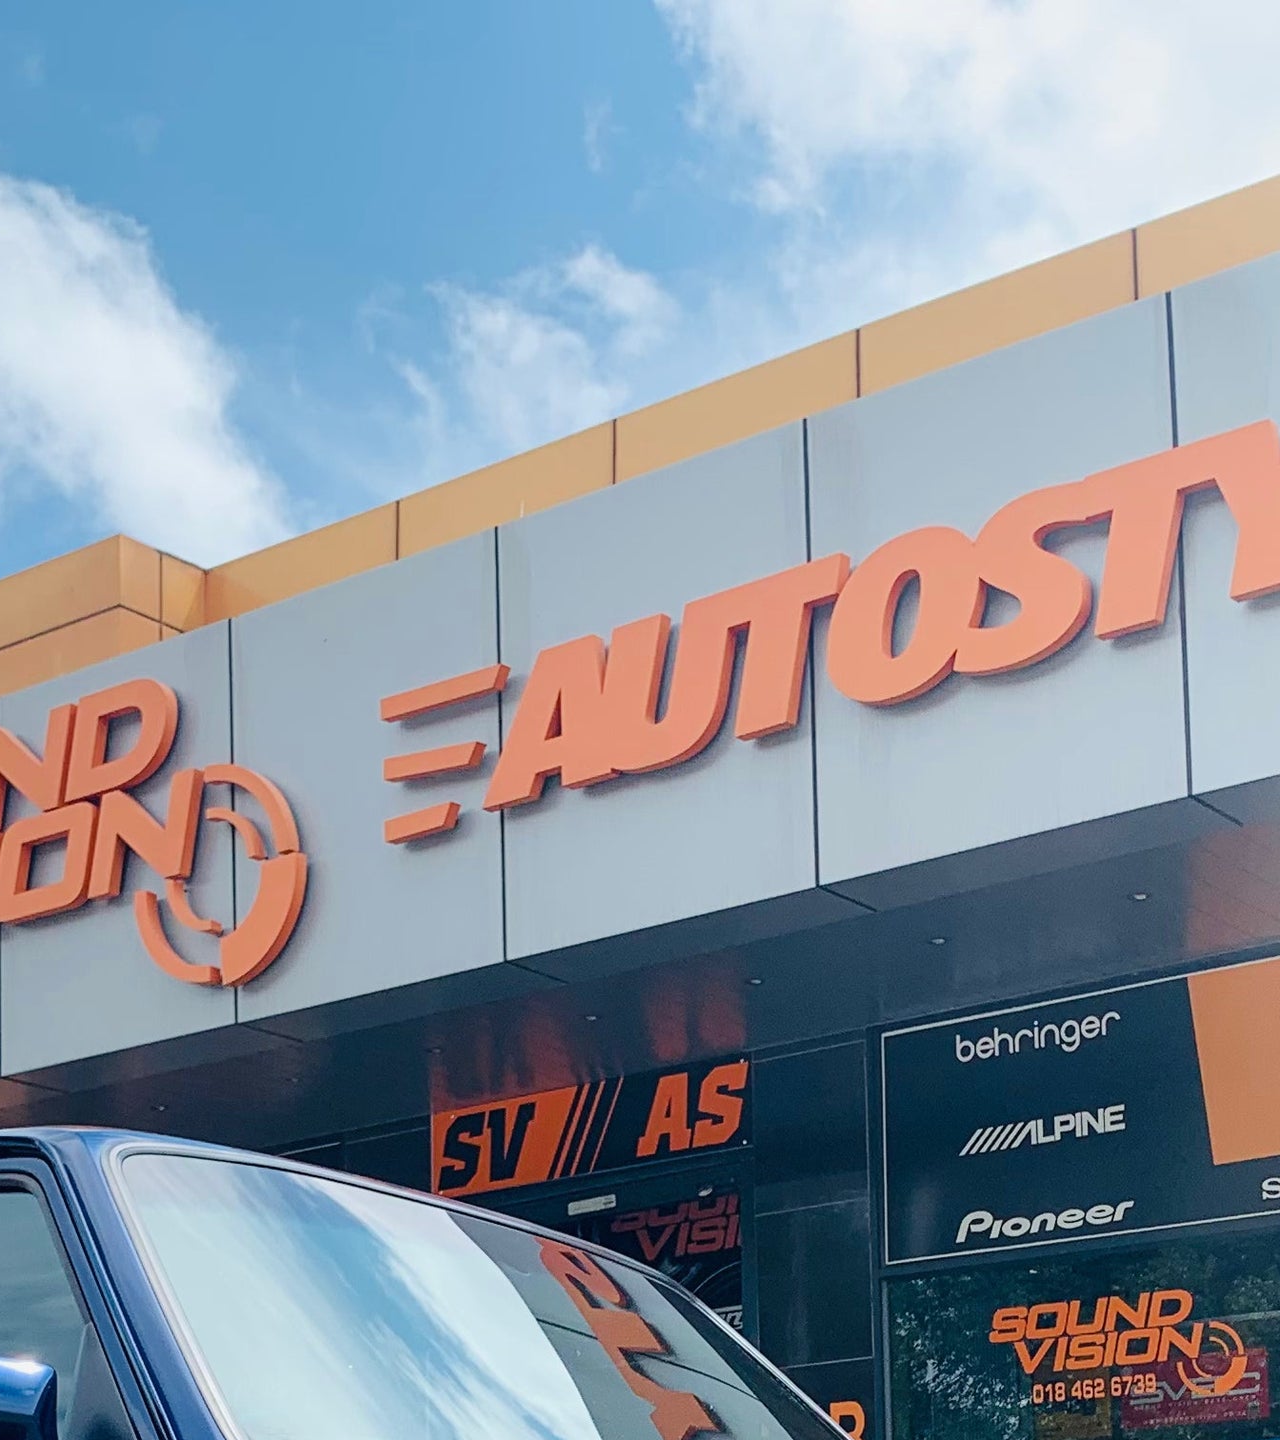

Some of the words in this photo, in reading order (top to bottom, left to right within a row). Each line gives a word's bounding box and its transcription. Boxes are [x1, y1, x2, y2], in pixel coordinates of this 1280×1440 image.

[955, 1011, 1121, 1063] behringer
[438, 1101, 536, 1193] SV
[636, 1060, 748, 1158] AS
[1016, 1103, 1126, 1148] ALPINE
[955, 1200, 1134, 1244] Pioneer
[989, 1289, 1193, 1343] SOUND
[1013, 1321, 1204, 1375] VISION
[1032, 1381, 1066, 1405] 018
[1071, 1377, 1105, 1400] 462
[1110, 1373, 1157, 1396] 6739
